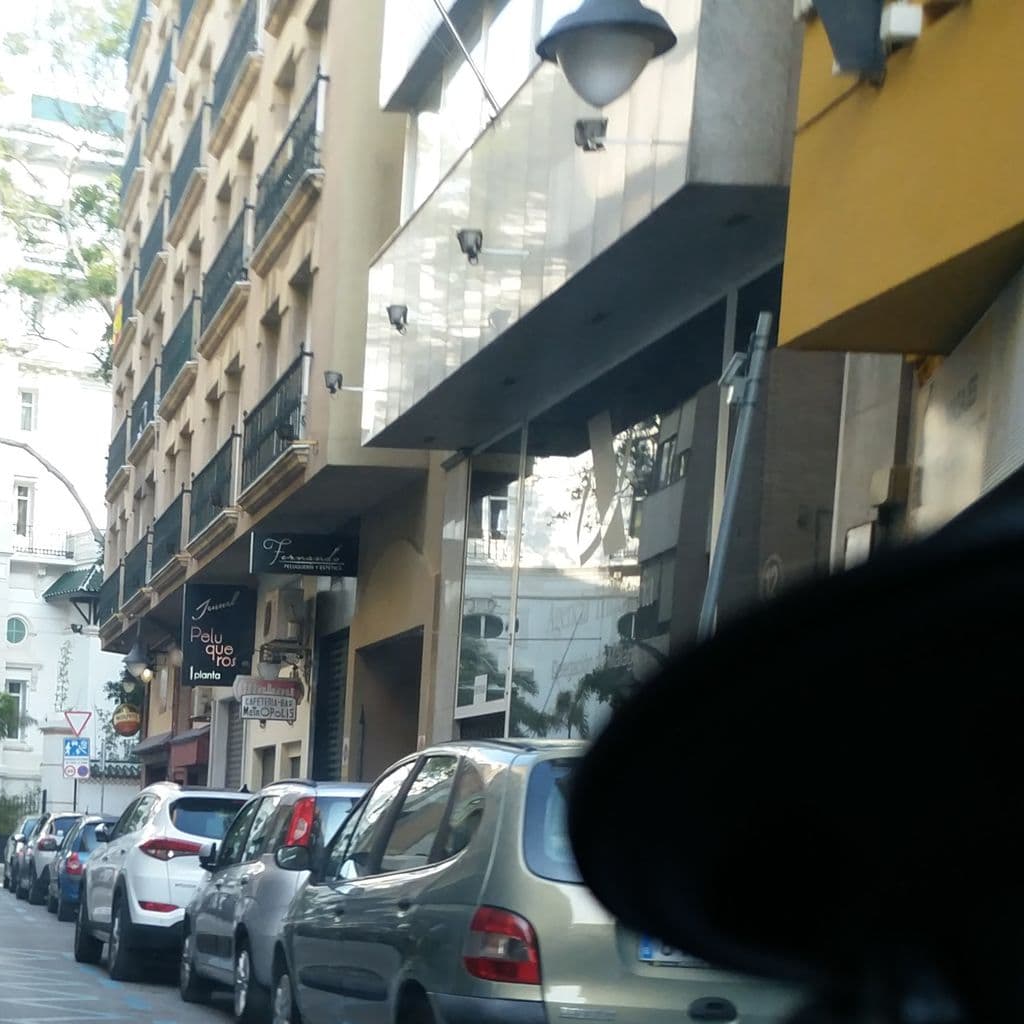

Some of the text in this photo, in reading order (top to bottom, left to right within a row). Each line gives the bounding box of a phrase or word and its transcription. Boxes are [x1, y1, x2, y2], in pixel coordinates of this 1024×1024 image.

[262, 538, 342, 566] Fernando
[190, 626, 223, 644] Pelu
[205, 644, 234, 662] que
[216, 656, 237, 668] ros
